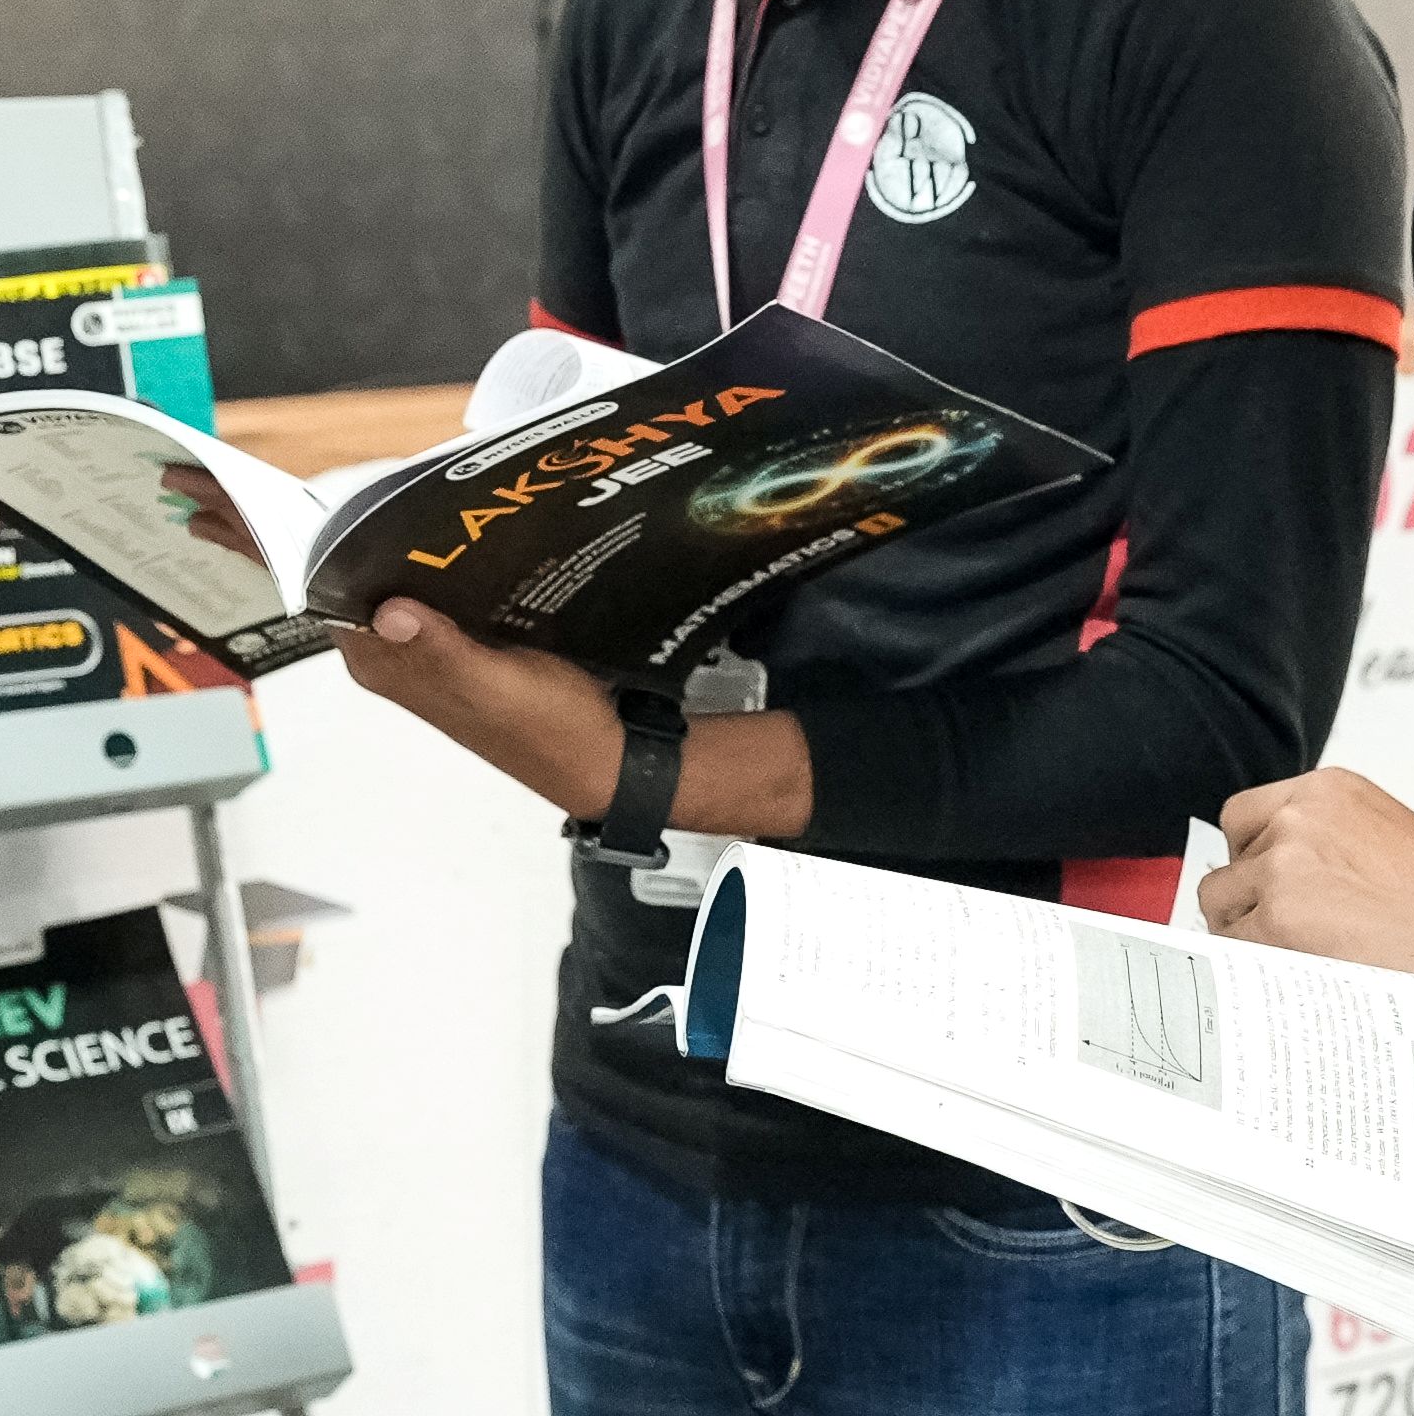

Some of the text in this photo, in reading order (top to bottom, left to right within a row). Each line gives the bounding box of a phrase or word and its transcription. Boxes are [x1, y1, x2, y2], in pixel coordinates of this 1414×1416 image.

[407, 385, 786, 570] LAKSHYA
[578, 442, 713, 506] JEE
[648, 528, 857, 665] MATHEMATICS
[5, 1016, 201, 1090] SCIENCE
